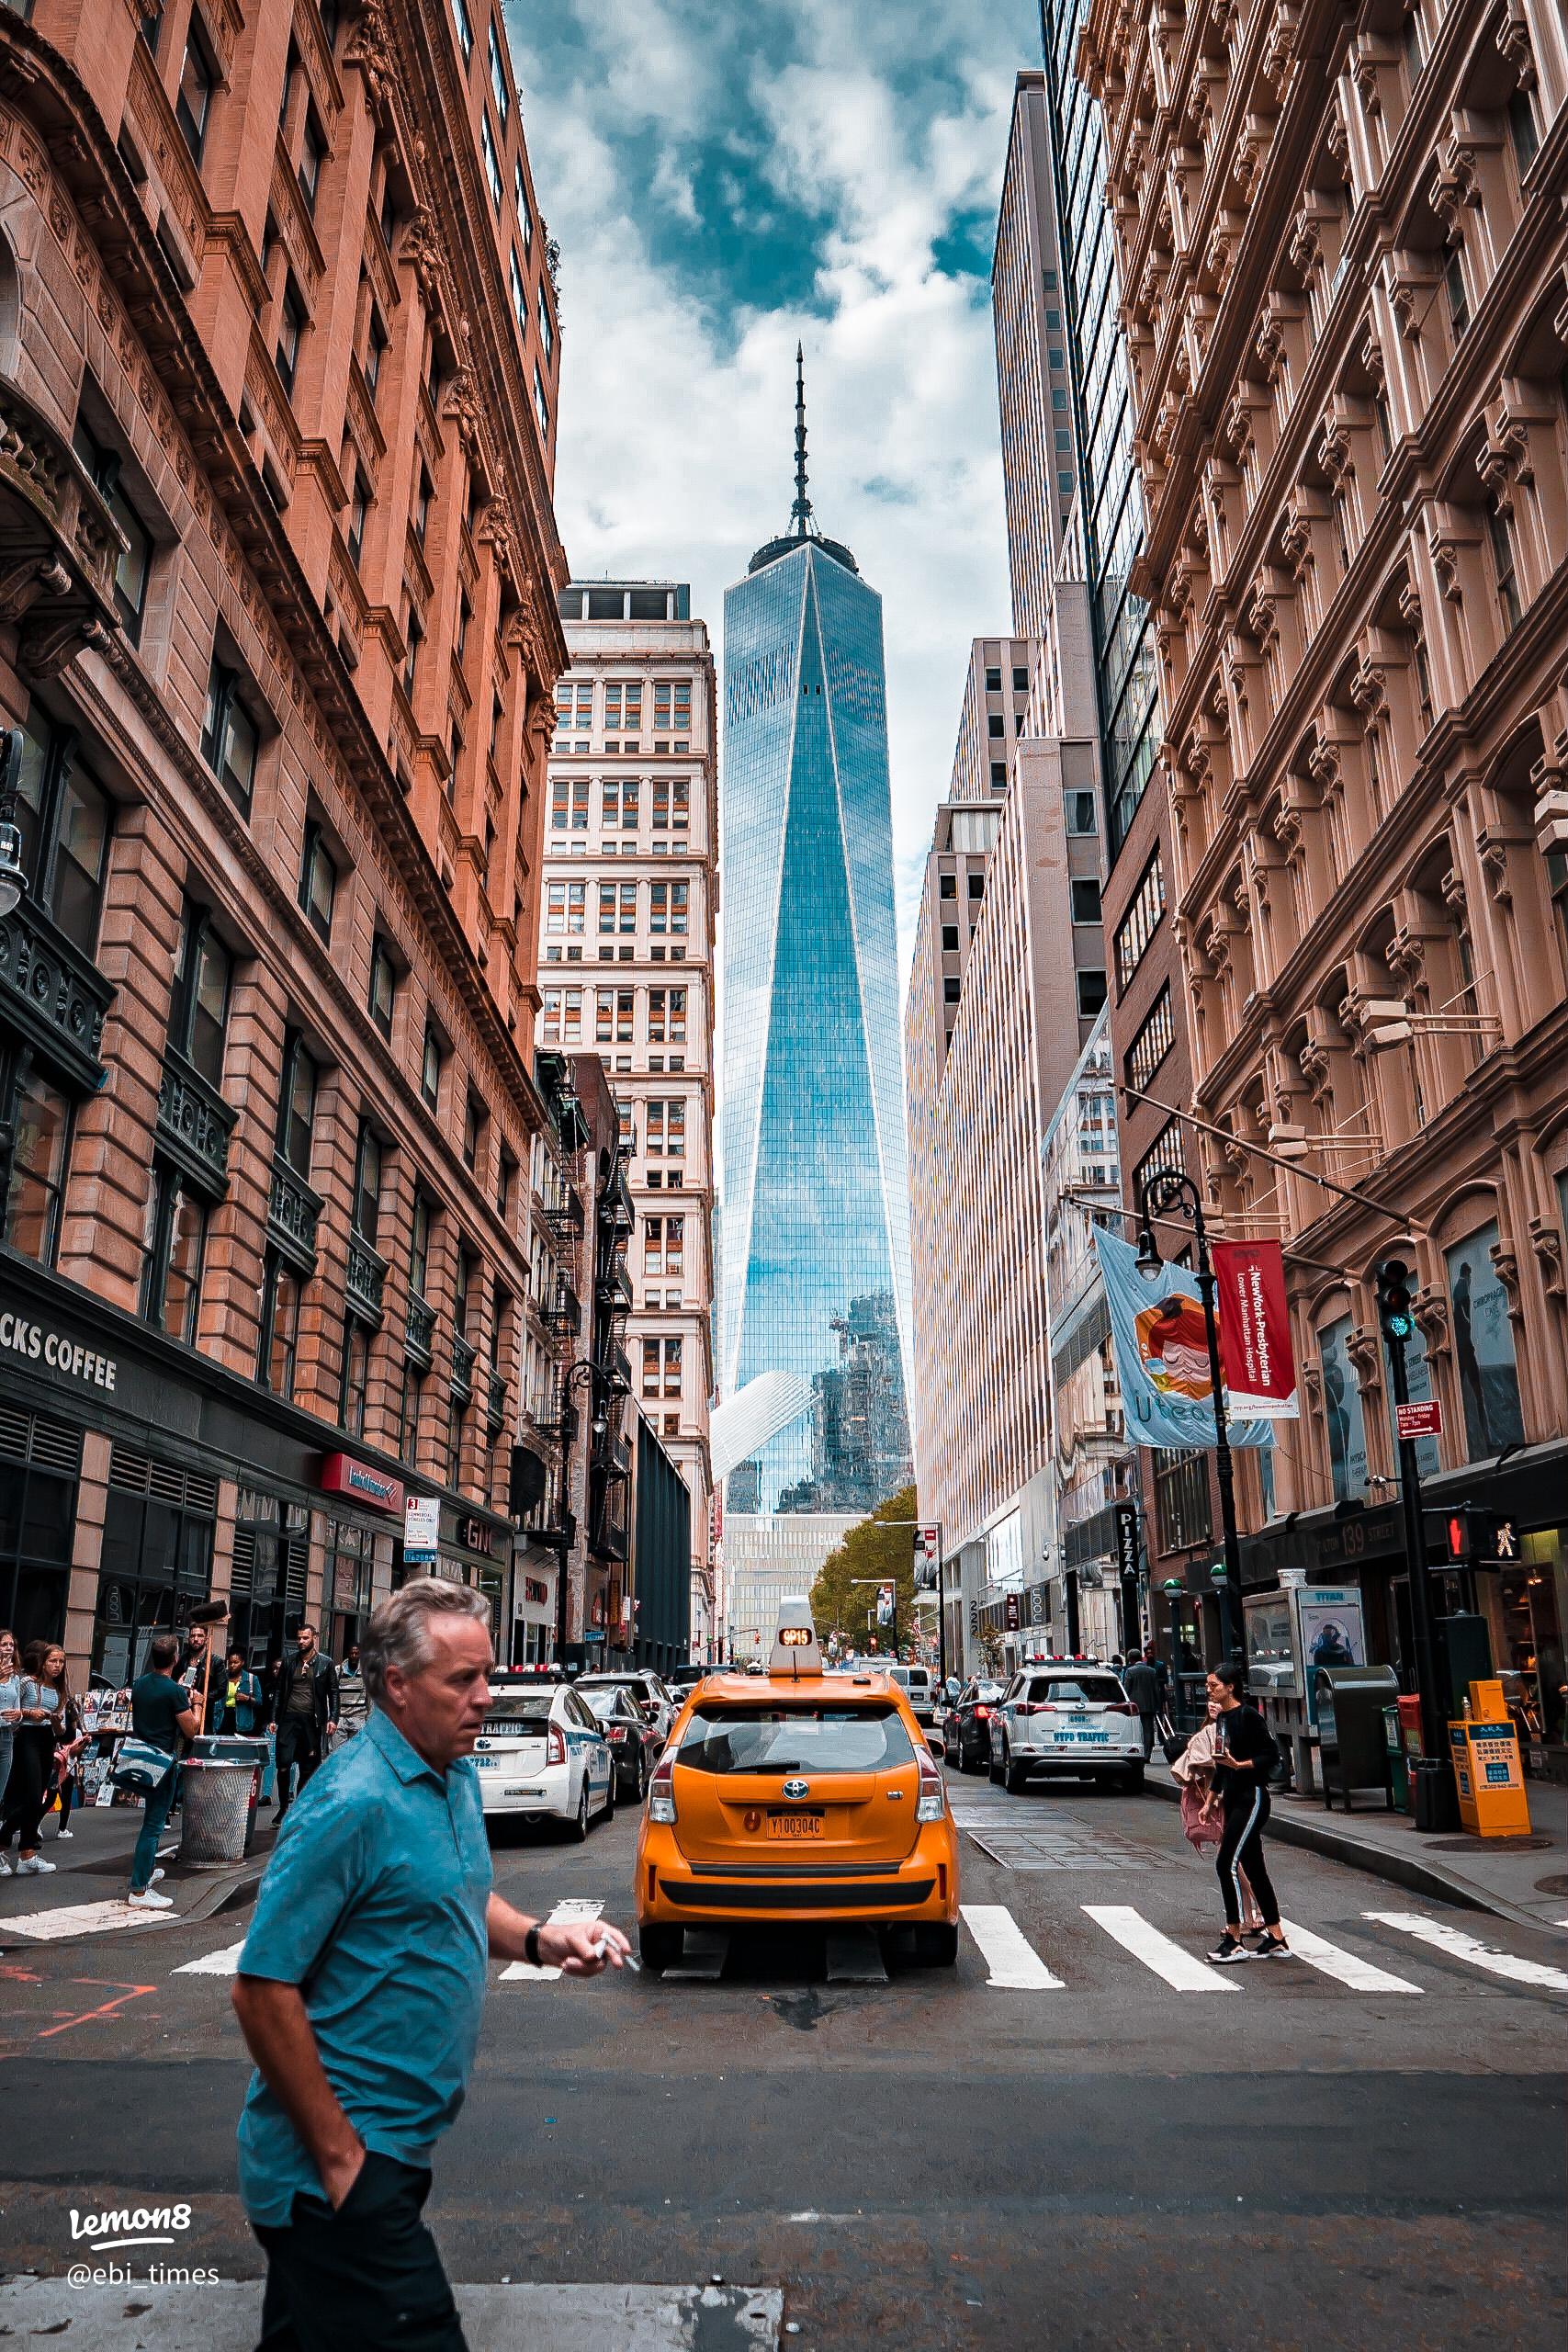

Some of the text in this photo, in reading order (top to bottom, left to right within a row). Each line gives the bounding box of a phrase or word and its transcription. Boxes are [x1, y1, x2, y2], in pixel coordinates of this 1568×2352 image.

[1237, 1272, 1257, 1382] Lower Manhattan Hospital
[0, 1313, 117, 1391] CKS COFFEE
[1407, 1405, 1433, 1414] STANDING
[410, 1499, 417, 1510] 3
[1121, 1513, 1135, 1575] PIZZA
[1343, 1522, 1364, 1556] 139
[1315, 1592, 1345, 1602] TITAN
[783, 1630, 808, 1645] 9P15
[480, 1722, 524, 1735] TRAFFIC
[1054, 1732, 1110, 1742] NYPD TRAFFIC
